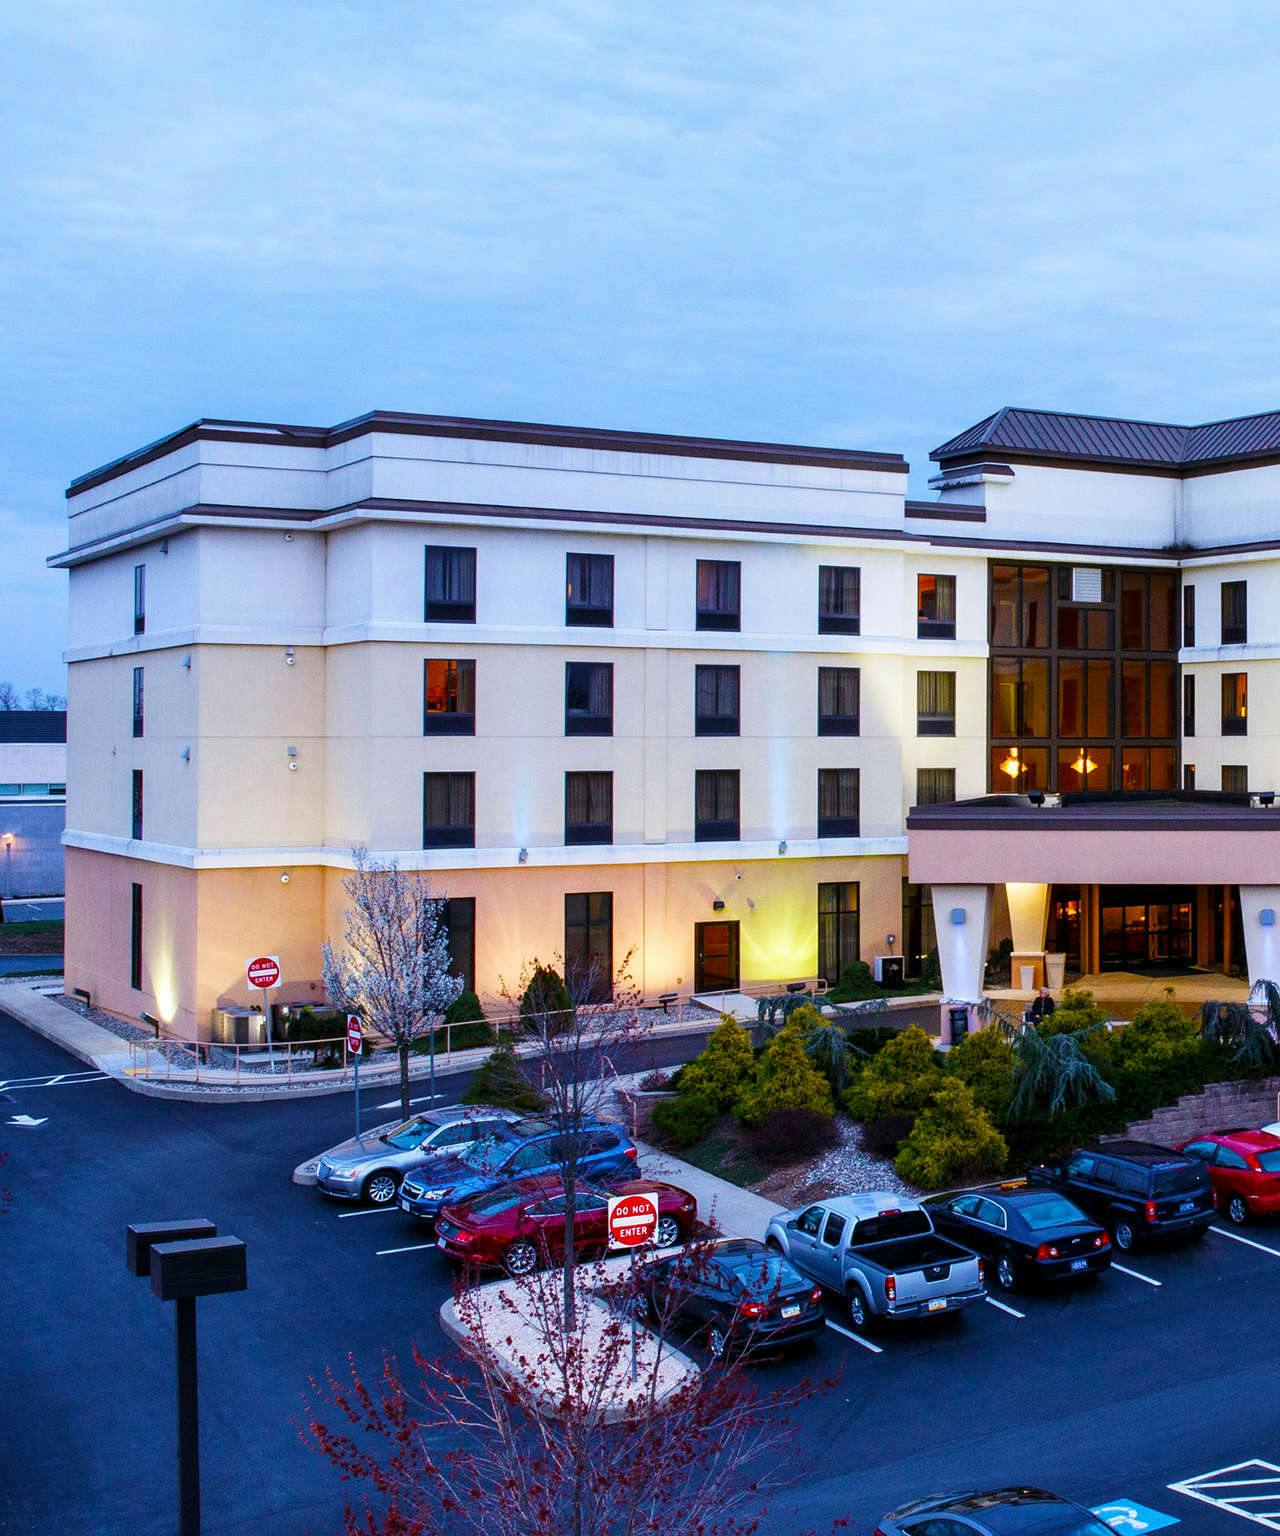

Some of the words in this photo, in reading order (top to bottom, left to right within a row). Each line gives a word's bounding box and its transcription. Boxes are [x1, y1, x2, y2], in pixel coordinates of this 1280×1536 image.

[616, 1207, 629, 1216] DO
[632, 1204, 650, 1214] NOT
[620, 1226, 648, 1238] ENTER
